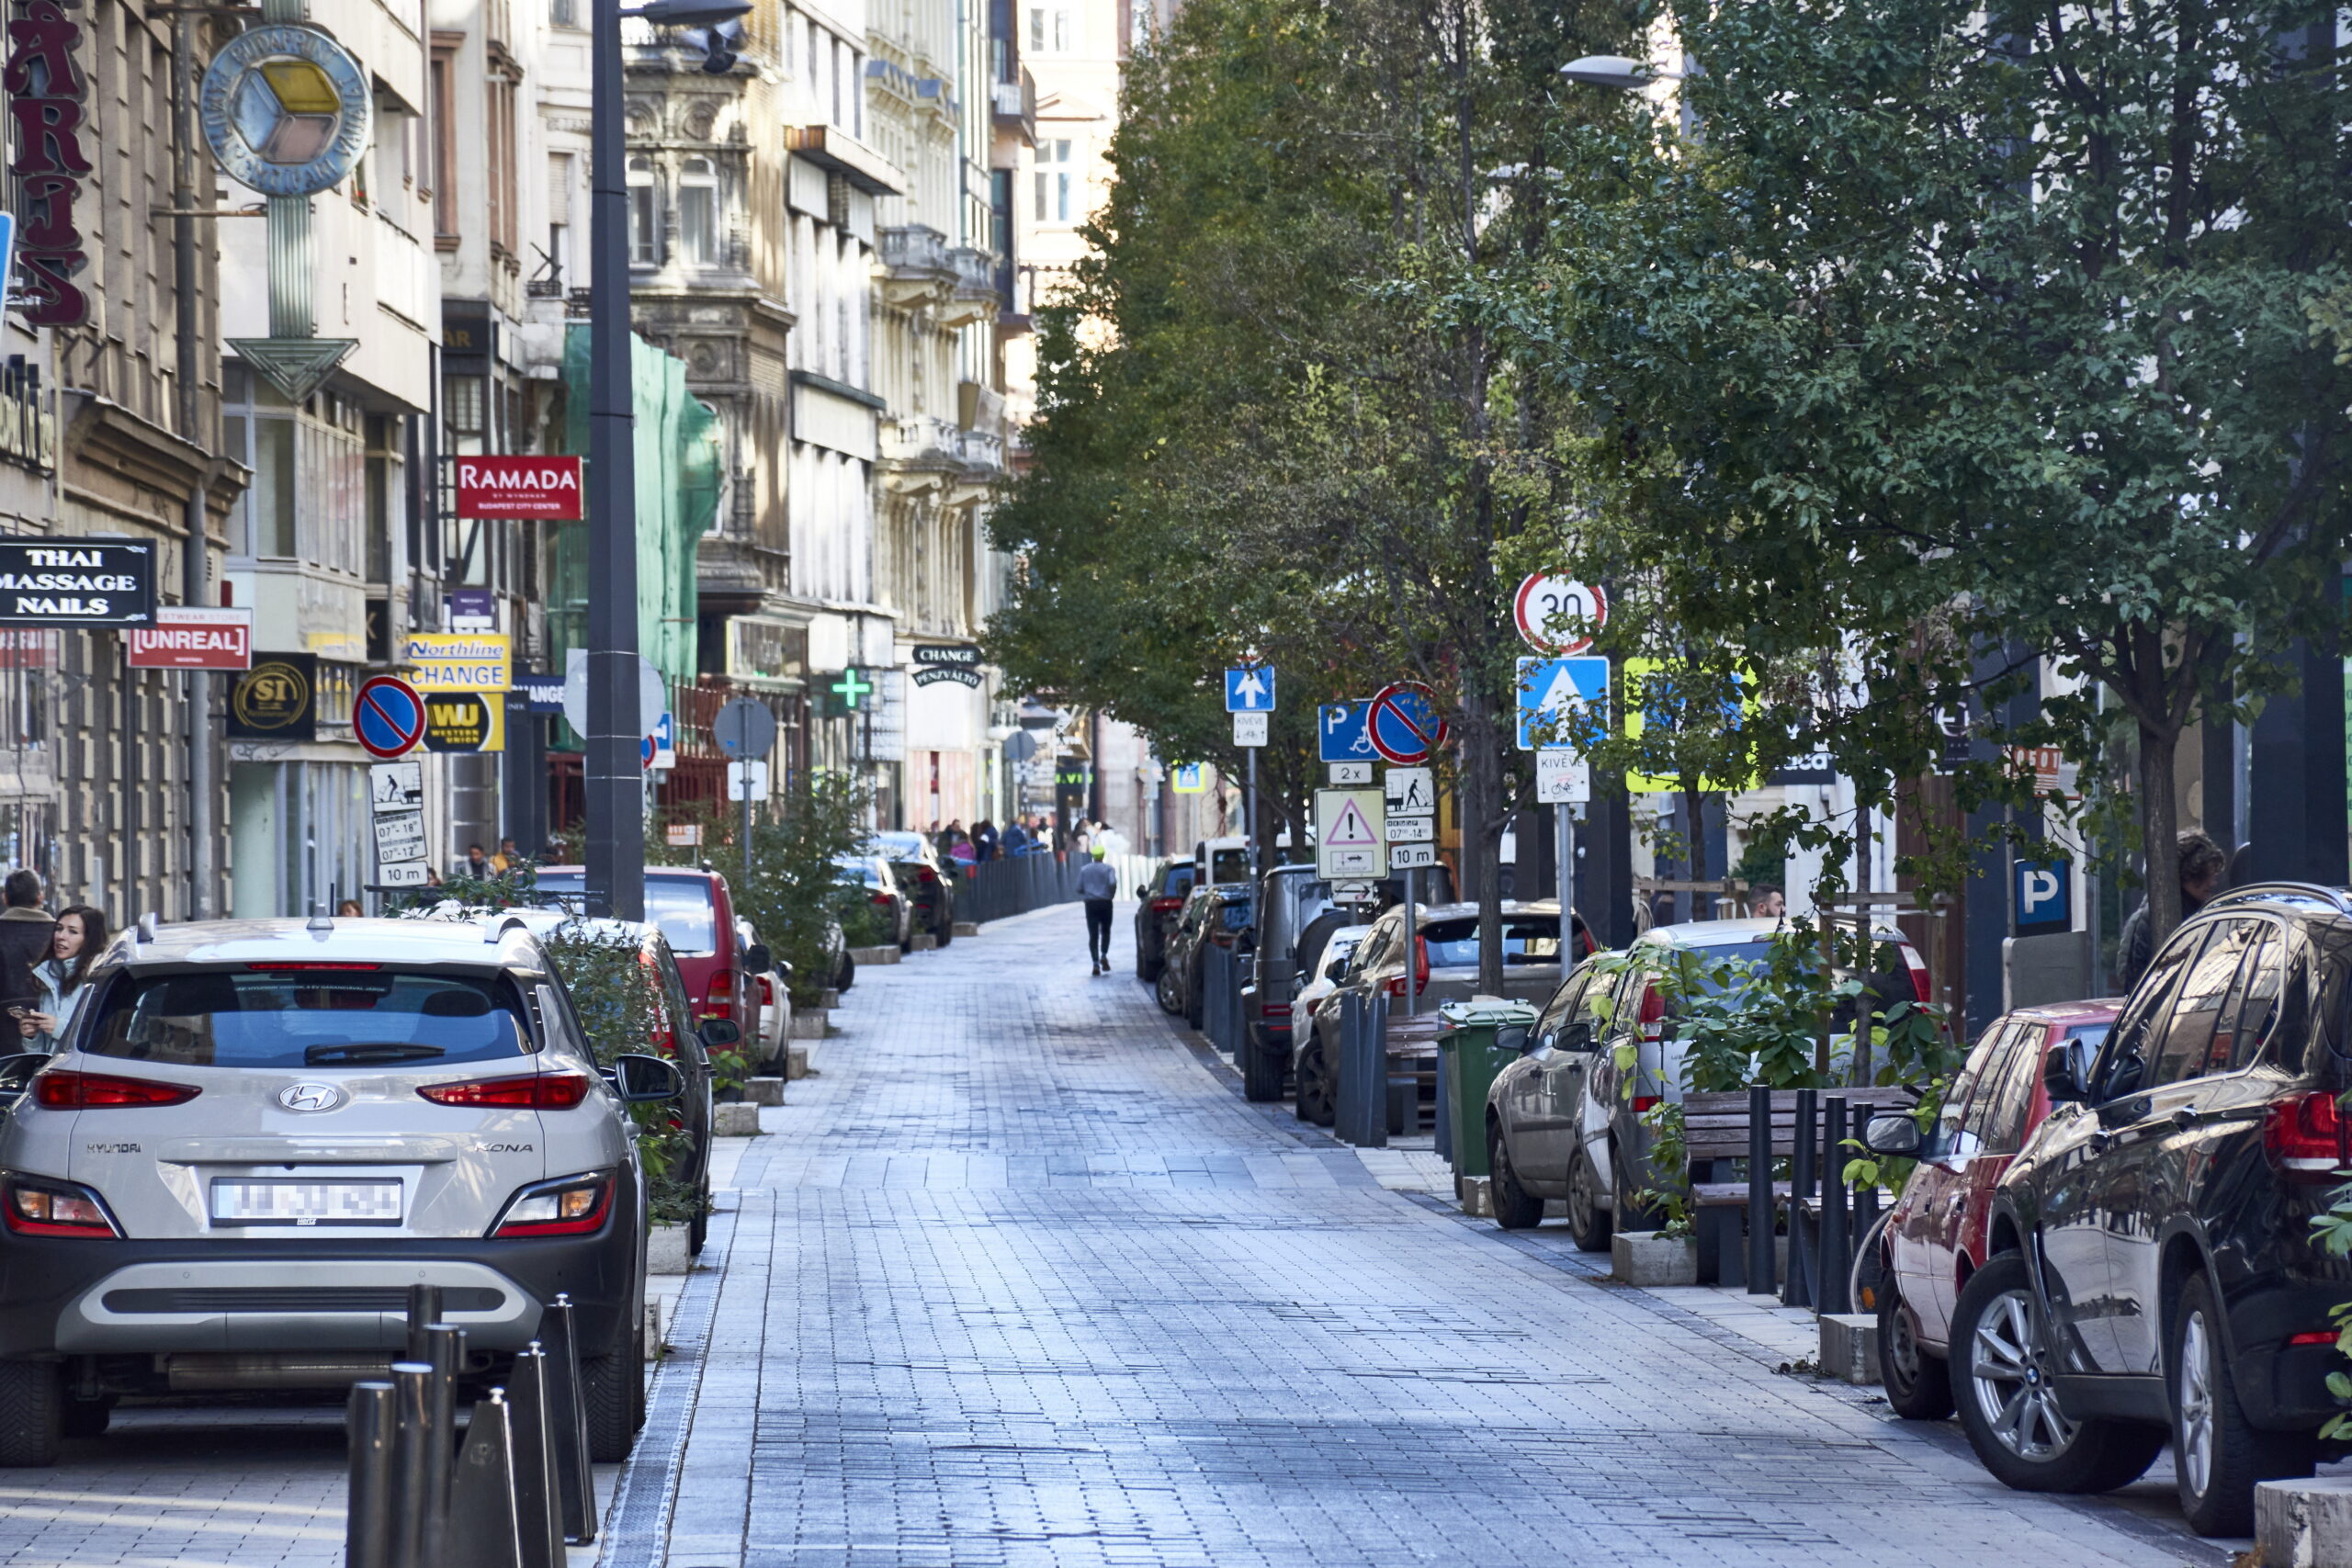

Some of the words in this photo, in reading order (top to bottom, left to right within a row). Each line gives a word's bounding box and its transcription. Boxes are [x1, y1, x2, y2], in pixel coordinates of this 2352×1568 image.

[460, 464, 577, 490] RAMADA
[533, 502, 560, 511] CENTER
[26, 549, 103, 567] THAI
[0, 573, 137, 592] MASSAGE
[16, 597, 109, 615] NAILS
[1542, 593, 1581, 626] 30
[409, 641, 503, 657] Northline
[920, 649, 974, 662] CHANGE
[409, 666, 503, 684] CHANGE
[254, 680, 288, 701] SI
[432, 704, 480, 727] WU
[1328, 706, 1348, 735] P
[1341, 768, 1350, 780] 2
[1396, 849, 1410, 864] 10
[1416, 850, 1430, 863] m
[388, 868, 401, 881] 10
[407, 870, 420, 880] m
[2023, 870, 2059, 914] P
[87, 1143, 141, 1154] HYUNDAI
[474, 1142, 533, 1153] KONA
[296, 1217, 317, 1226] Hertz
